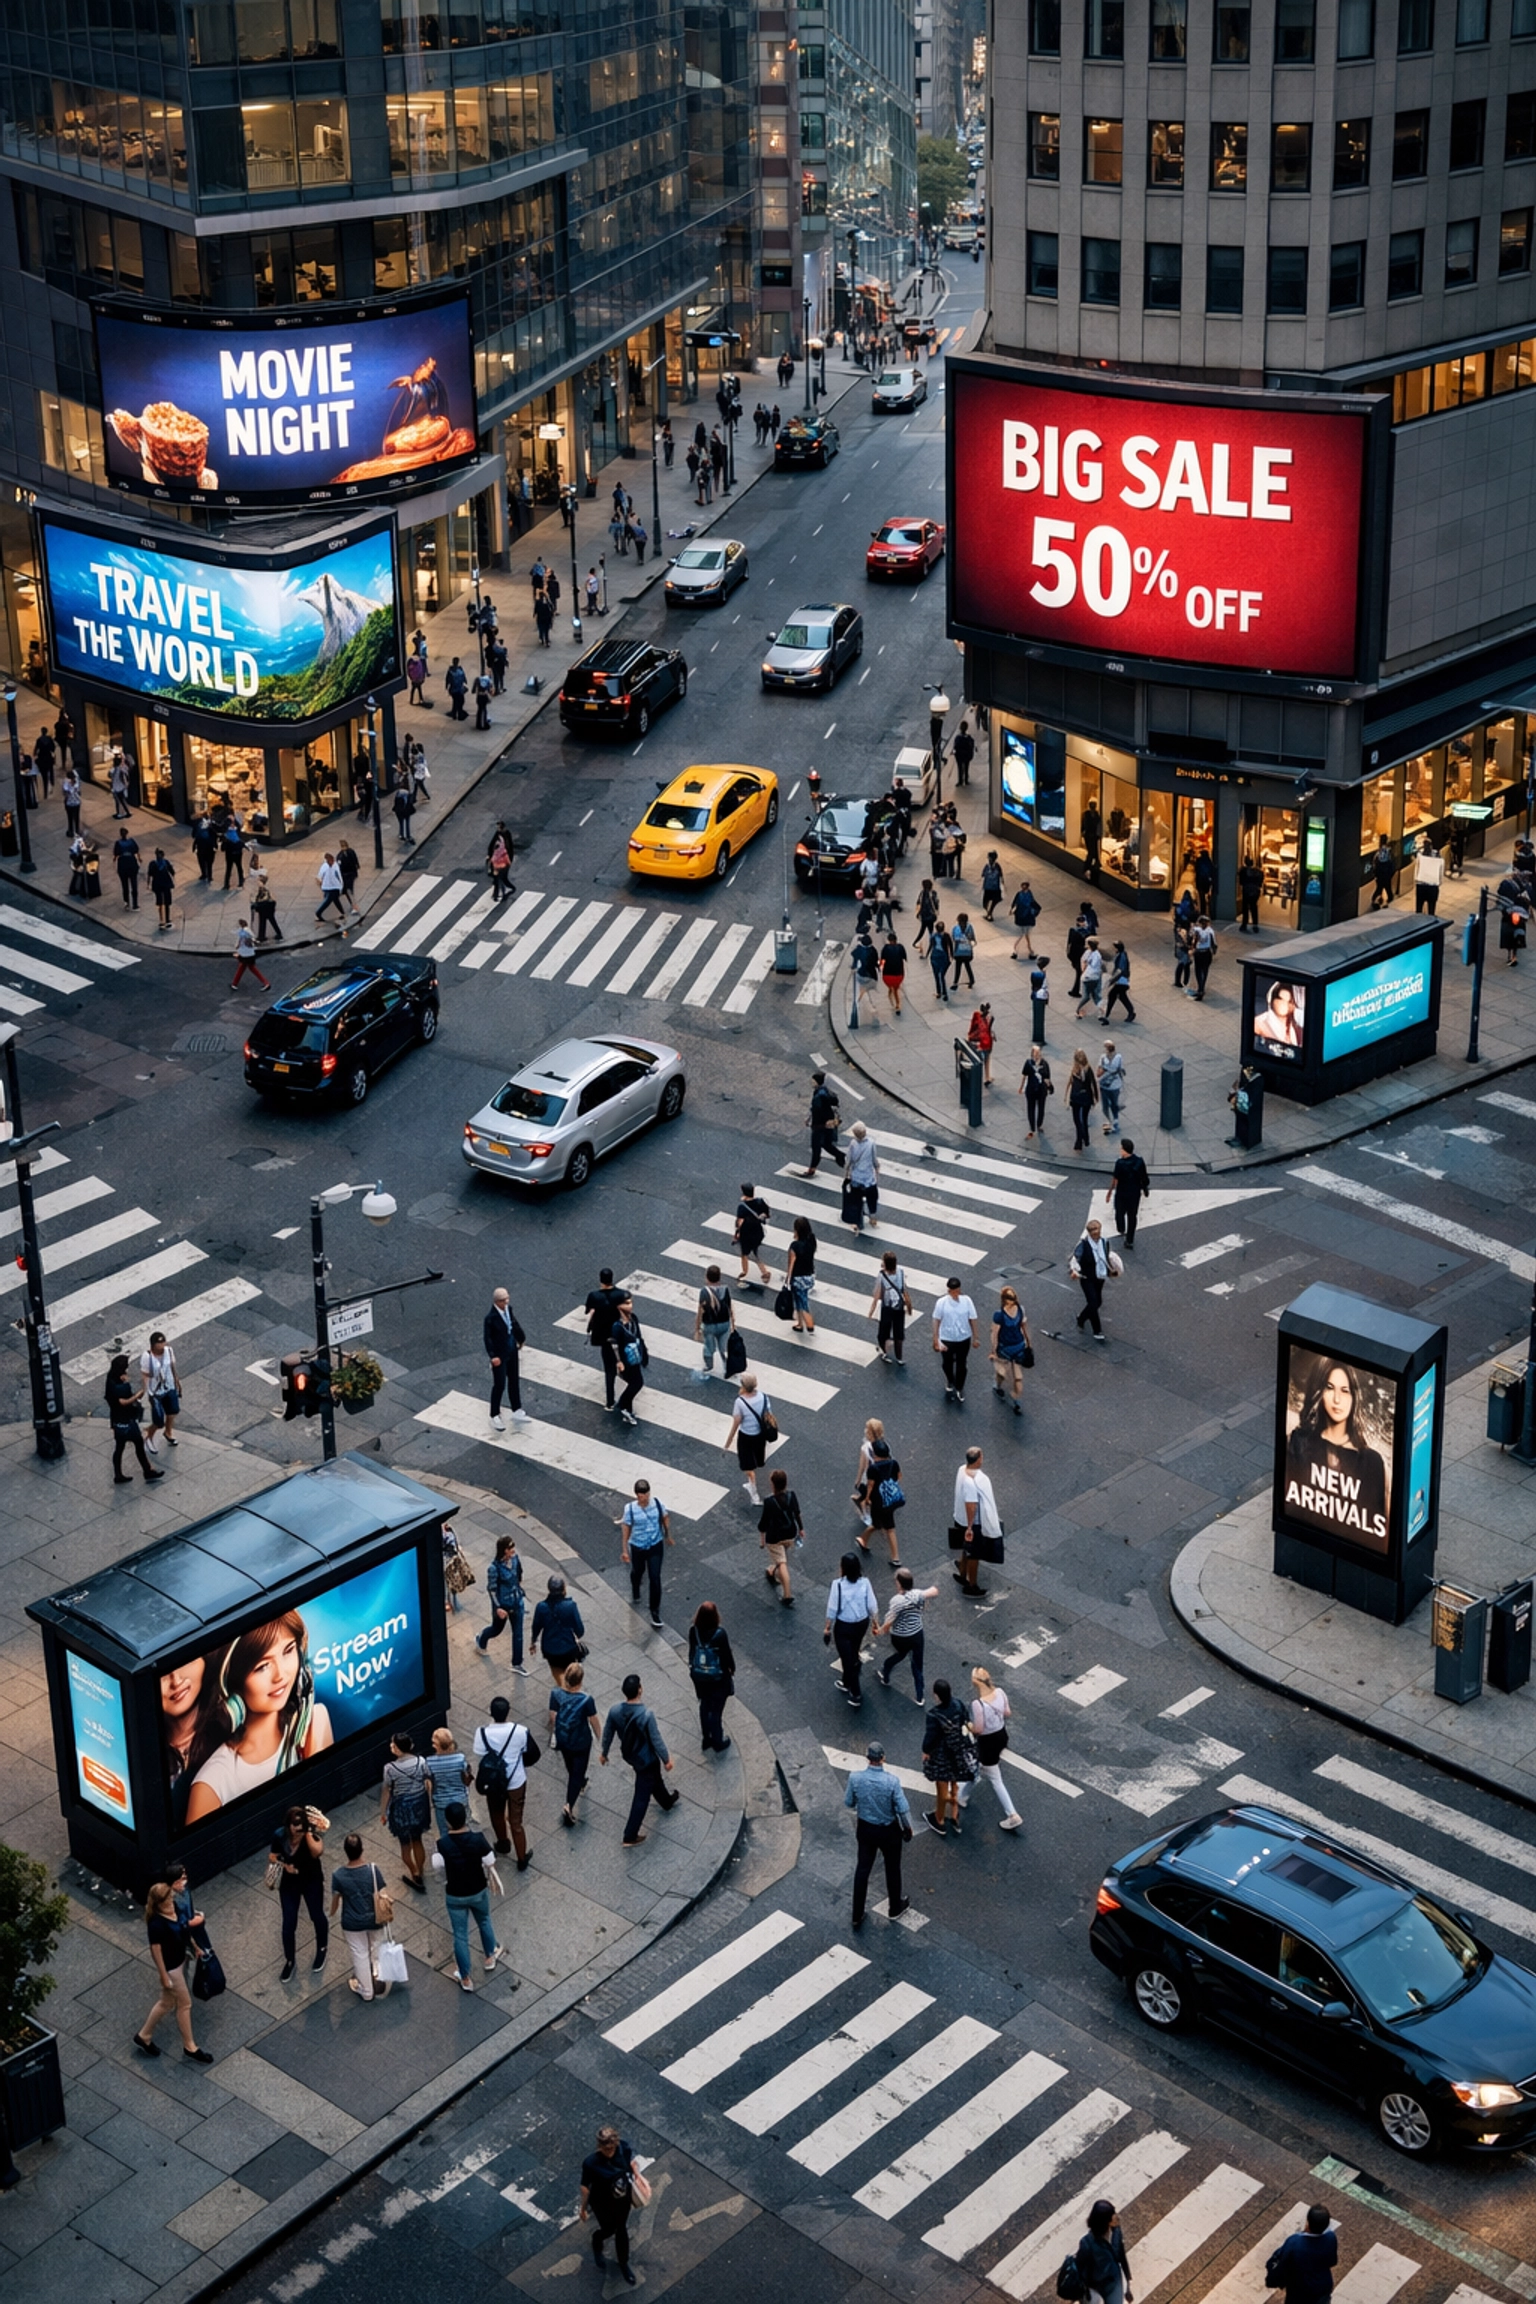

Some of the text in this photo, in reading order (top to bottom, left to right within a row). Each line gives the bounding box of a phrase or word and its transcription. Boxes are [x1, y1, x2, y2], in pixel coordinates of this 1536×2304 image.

[219, 343, 355, 400] MOVIE
[225, 400, 355, 456] NIGHT
[1003, 420, 1293, 521] BIG SALE
[90, 563, 235, 641] TRAVEL
[1029, 516, 1263, 632] 50% OFF
[73, 616, 259, 697] THE WORLD
[1285, 1481, 1387, 1538] ARRIVALS
[1310, 1462, 1361, 1500] NEW
[313, 1613, 408, 1674] Stream
[336, 1647, 394, 1694] Now
